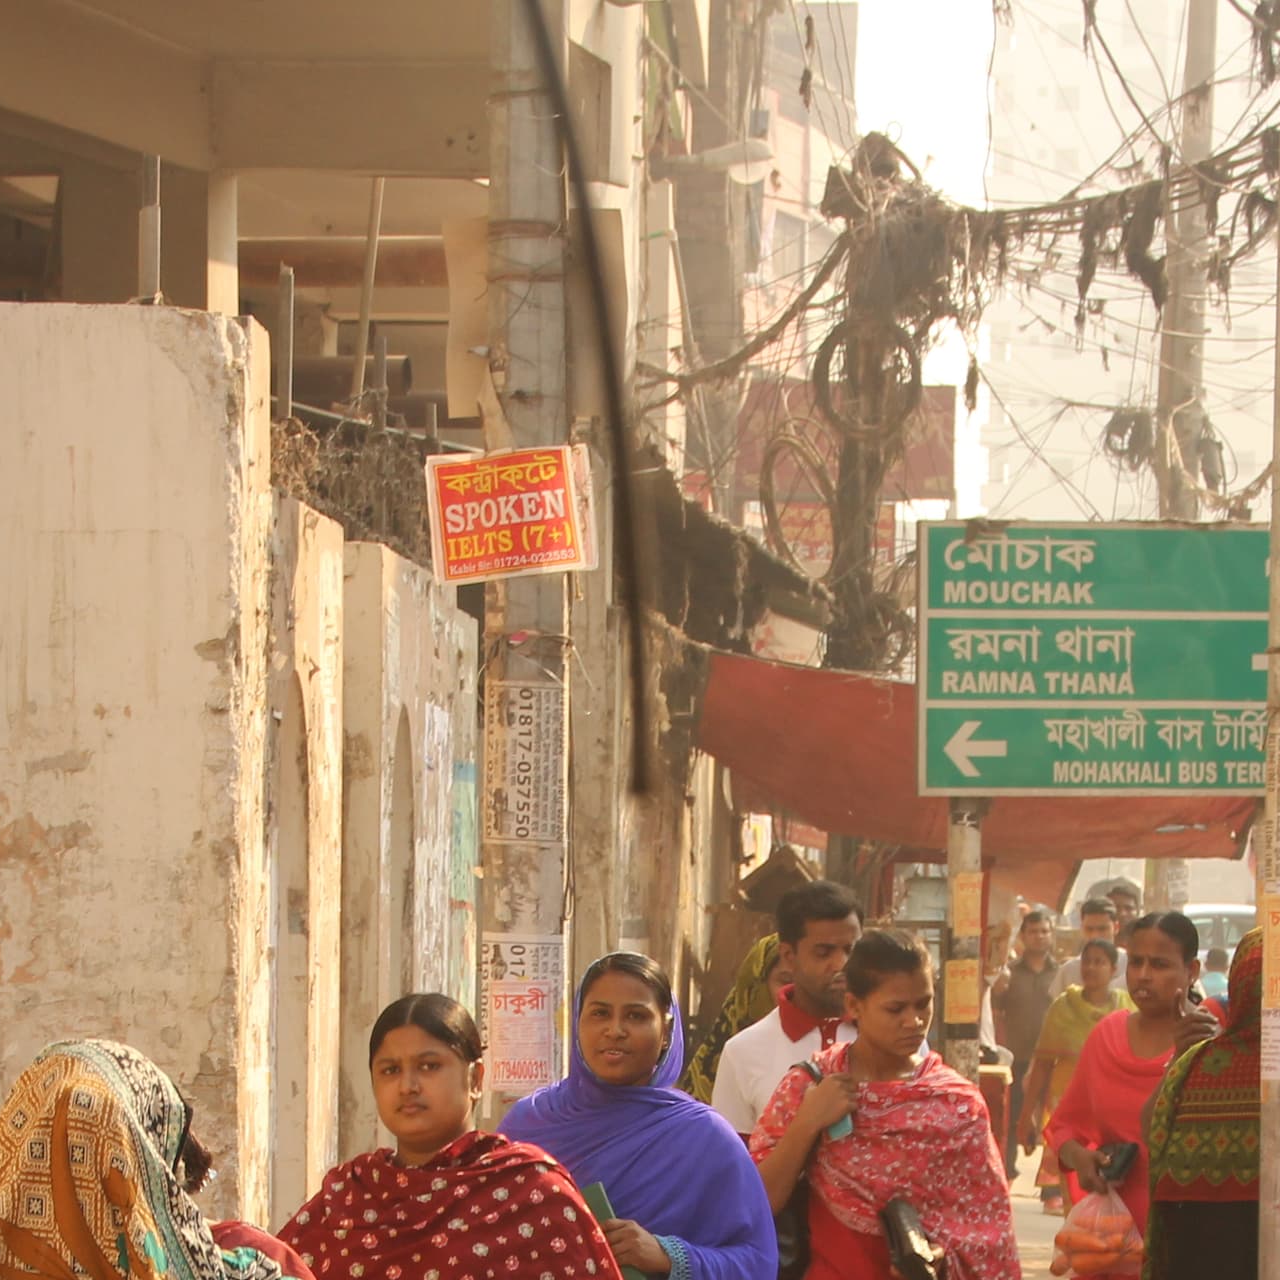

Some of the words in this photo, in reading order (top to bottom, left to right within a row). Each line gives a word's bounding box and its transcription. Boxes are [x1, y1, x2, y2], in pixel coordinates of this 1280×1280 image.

[445, 488, 566, 534] SPOKEN
[448, 529, 513, 561] IELTS
[521, 521, 572, 551] (7+)
[943, 580, 1095, 604] MOUCHAK
[945, 625, 1042, 663] রমনা
[1055, 625, 1136, 663] থানা
[942, 671, 1036, 694] RAMNA
[1044, 671, 1135, 694] THANA
[1043, 708, 1147, 752] মহাখালী
[1156, 716, 1205, 751] বাস
[515, 687, 534, 839] 01817-057550
[1053, 761, 1171, 784] MOHAKHALI
[1178, 761, 1218, 784] BUS
[1224, 761, 1266, 784] TER
[493, 988, 548, 1015] চাকুরী
